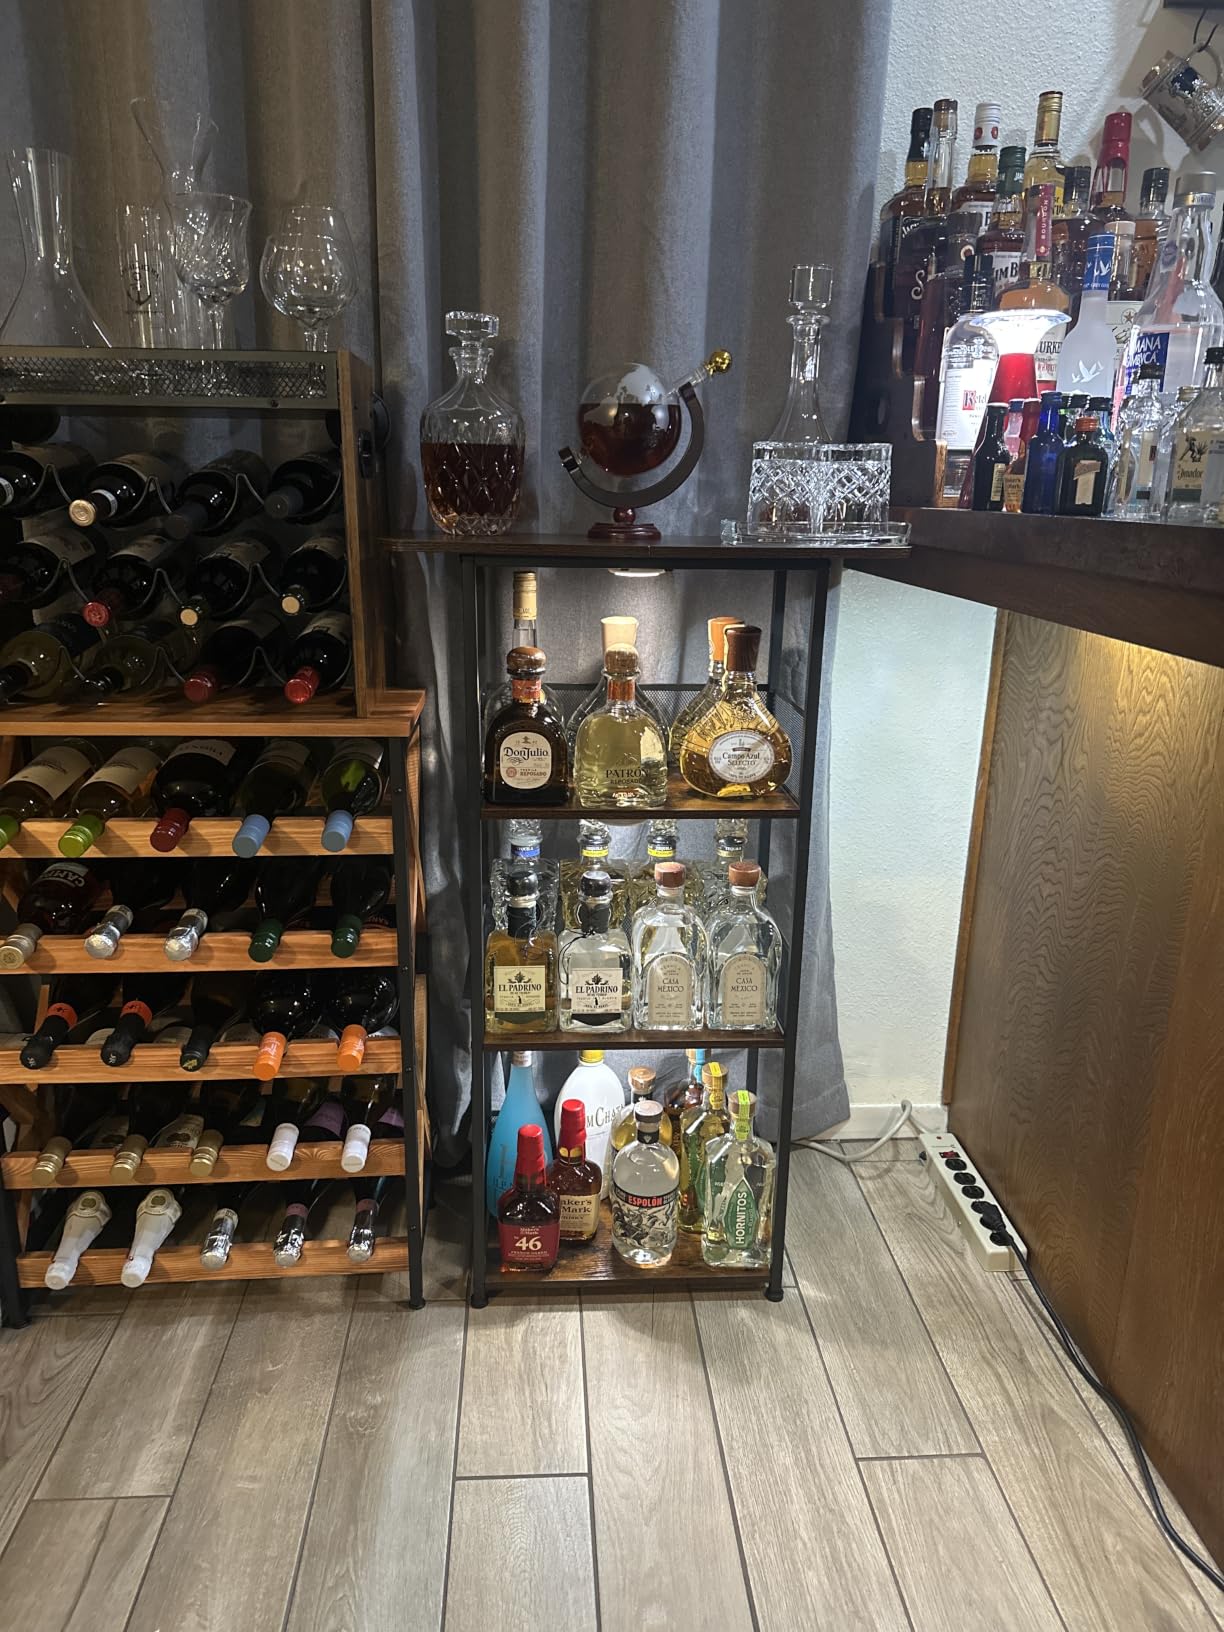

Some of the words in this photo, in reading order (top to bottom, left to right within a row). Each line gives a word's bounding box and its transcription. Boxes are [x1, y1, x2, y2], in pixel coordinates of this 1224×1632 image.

[1040, 199, 1049, 240] BOURBON
[722, 752, 745, 760] Campo
[746, 752, 760, 760] Azul
[662, 977, 679, 985] CASA
[735, 977, 753, 985] CASA
[498, 983, 509, 992] EL
[509, 983, 542, 992] PADRINO
[575, 985, 585, 994] EL
[585, 985, 618, 994] PADRINO
[735, 1191, 748, 1245] HORNITOS
[515, 1236, 542, 1251] 46
